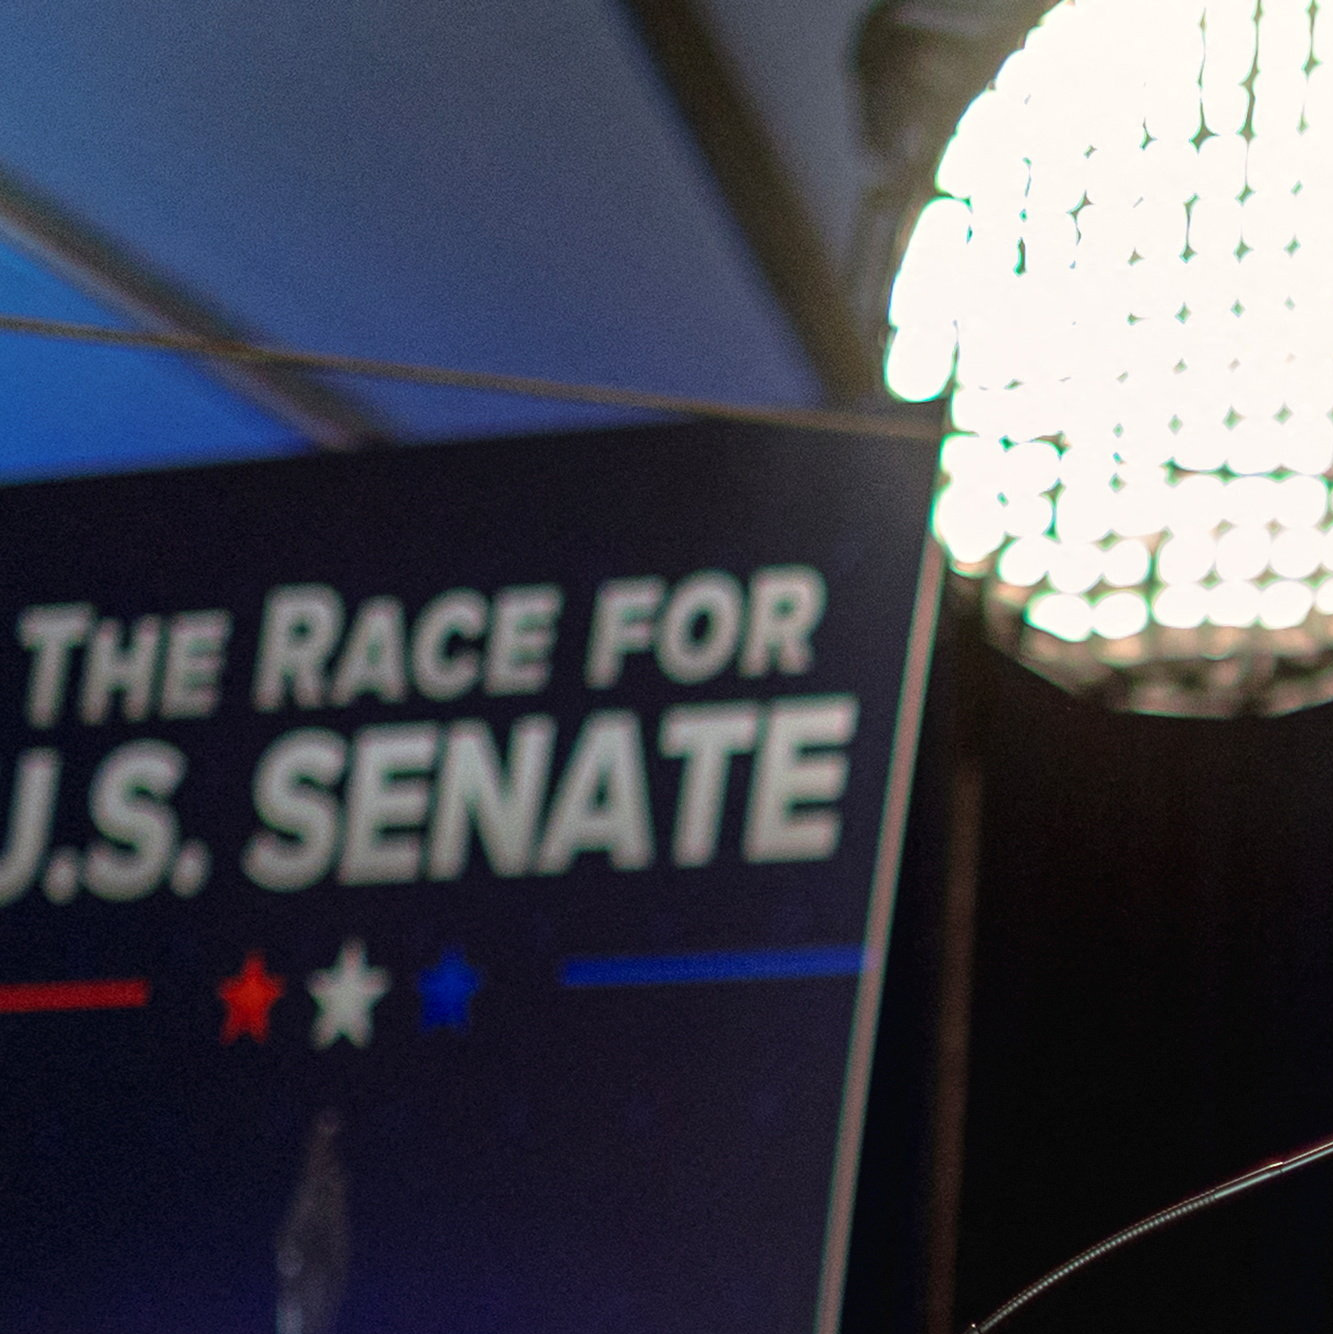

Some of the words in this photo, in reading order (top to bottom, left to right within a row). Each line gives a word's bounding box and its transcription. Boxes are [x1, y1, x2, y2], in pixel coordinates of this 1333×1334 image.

[18, 602, 231, 727] THE
[252, 583, 563, 712] RACE
[586, 566, 828, 688] FOR
[241, 692, 860, 893] SENATE
